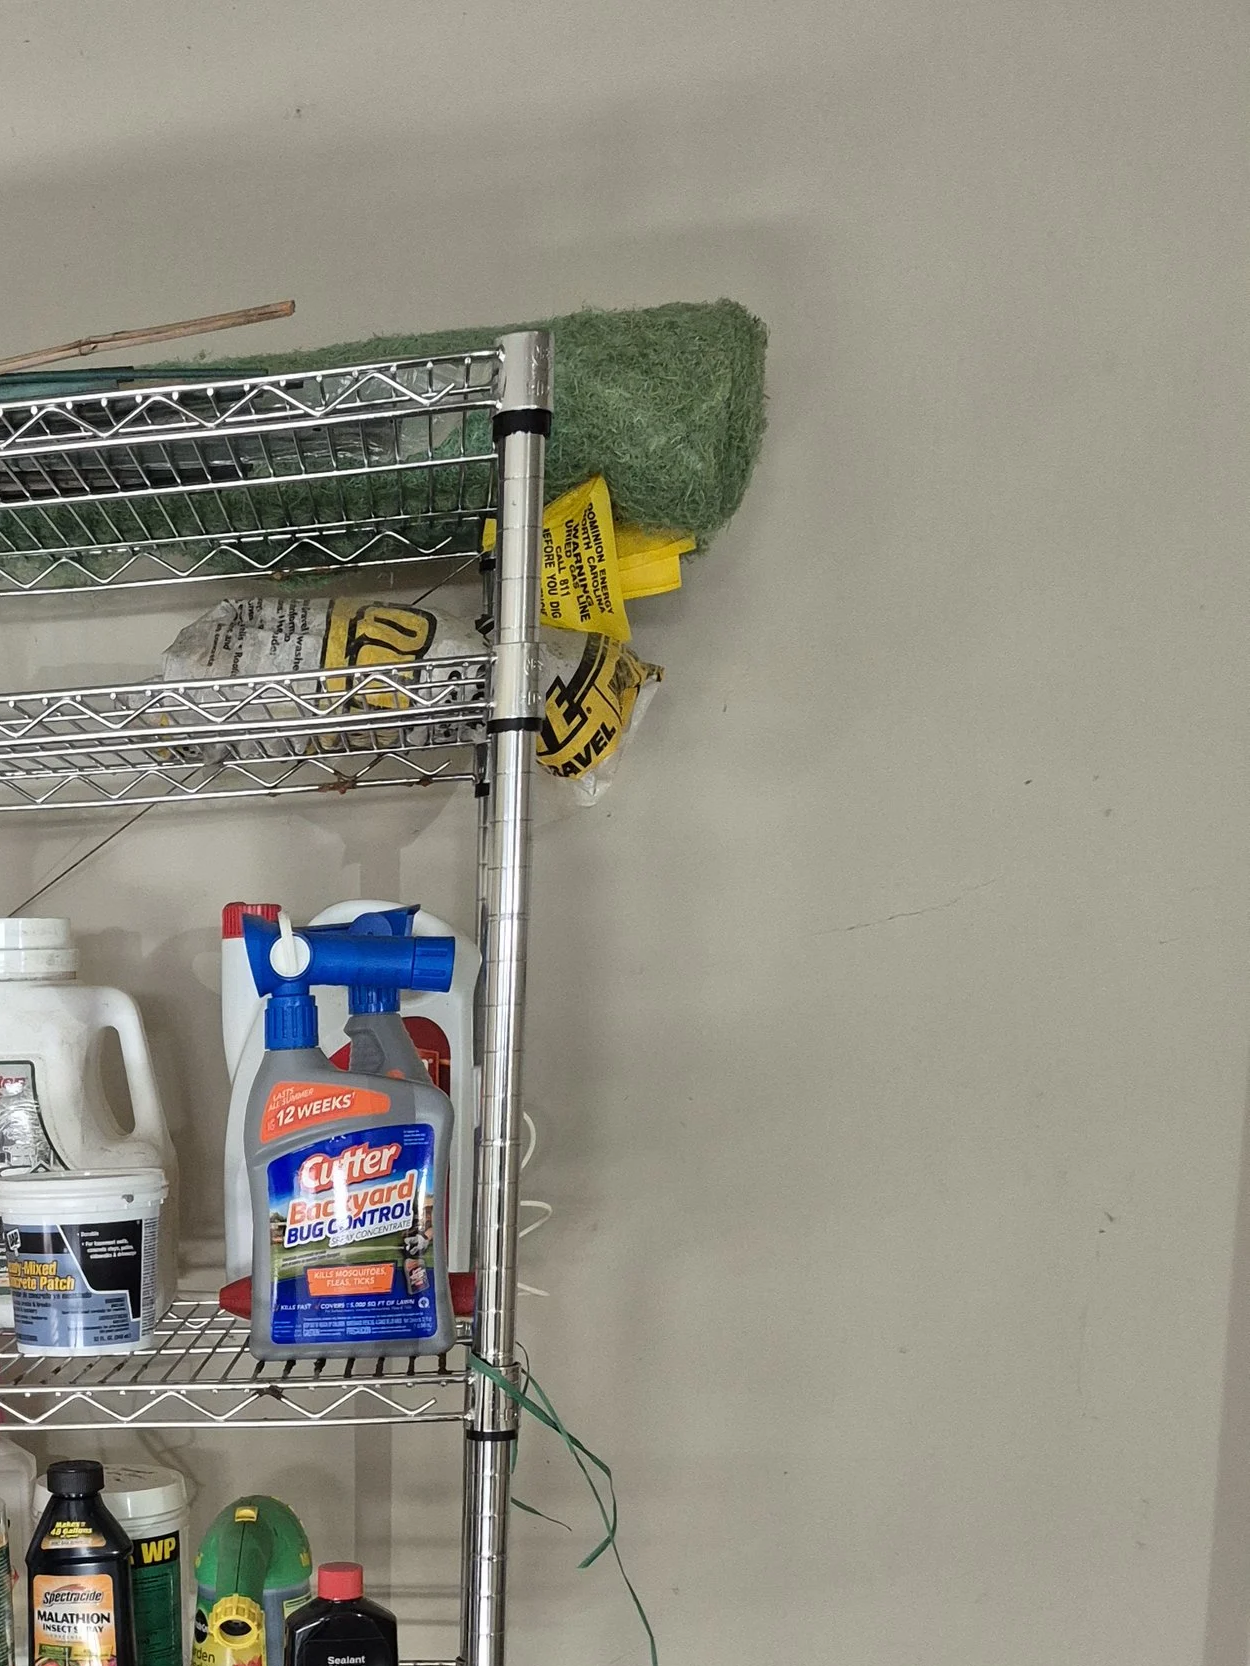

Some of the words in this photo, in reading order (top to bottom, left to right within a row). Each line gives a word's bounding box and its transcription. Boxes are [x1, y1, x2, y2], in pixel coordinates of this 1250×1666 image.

[556, 546, 567, 575] CALL
[572, 523, 594, 607] WARNING
[586, 502, 606, 564] DOMINION
[599, 568, 615, 615] ENERGY
[546, 574, 558, 596] YOU
[559, 578, 571, 597] 811
[570, 565, 580, 590] GAS
[576, 594, 591, 623] LINE
[587, 556, 607, 614] CAROLINA
[549, 601, 562, 620] DIG
[276, 1105, 295, 1126] 12
[297, 1094, 351, 1119] WEEKS
[300, 1145, 397, 1189] Cutter
[287, 1222, 324, 1245] BUG
[355, 1221, 412, 1241] CONCENTRATE
[313, 1270, 334, 1279] KILLS
[335, 1268, 387, 1278] MOSQUITOES,
[353, 1277, 375, 1286] TICKS
[39, 1276, 75, 1291] Patch
[50, 1528, 61, 1536] 48
[62, 1526, 93, 1536] Gallons
[55, 1521, 80, 1530] Makes
[141, 1537, 176, 1564] WP
[43, 1591, 102, 1607] Spectracide
[37, 1610, 111, 1624] MALATHION
[43, 1624, 71, 1633] INSECT
[327, 1655, 366, 1665] Sealant
